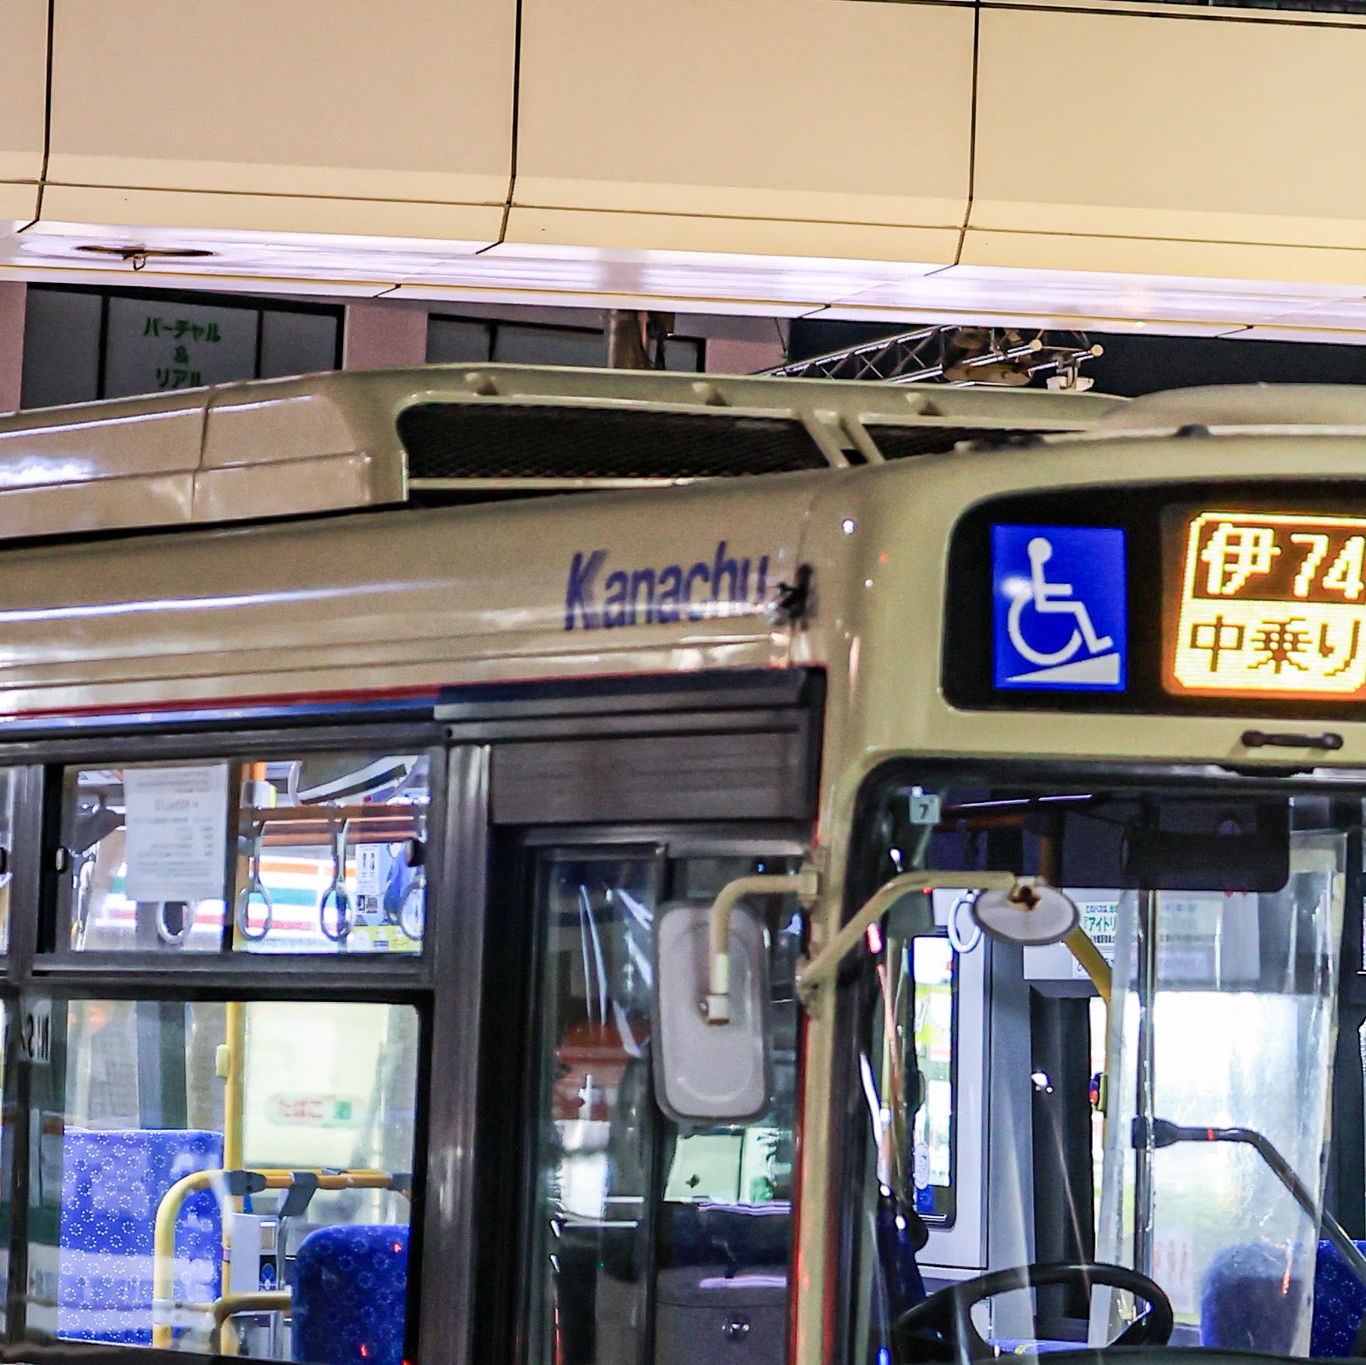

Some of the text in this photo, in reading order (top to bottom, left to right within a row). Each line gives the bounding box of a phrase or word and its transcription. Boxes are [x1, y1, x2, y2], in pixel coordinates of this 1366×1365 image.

[173, 345, 189, 364] &
[563, 539, 771, 632] Kanachu
[1200, 522, 1366, 600] 伊74
[1188, 613, 1362, 677] 中乗り
